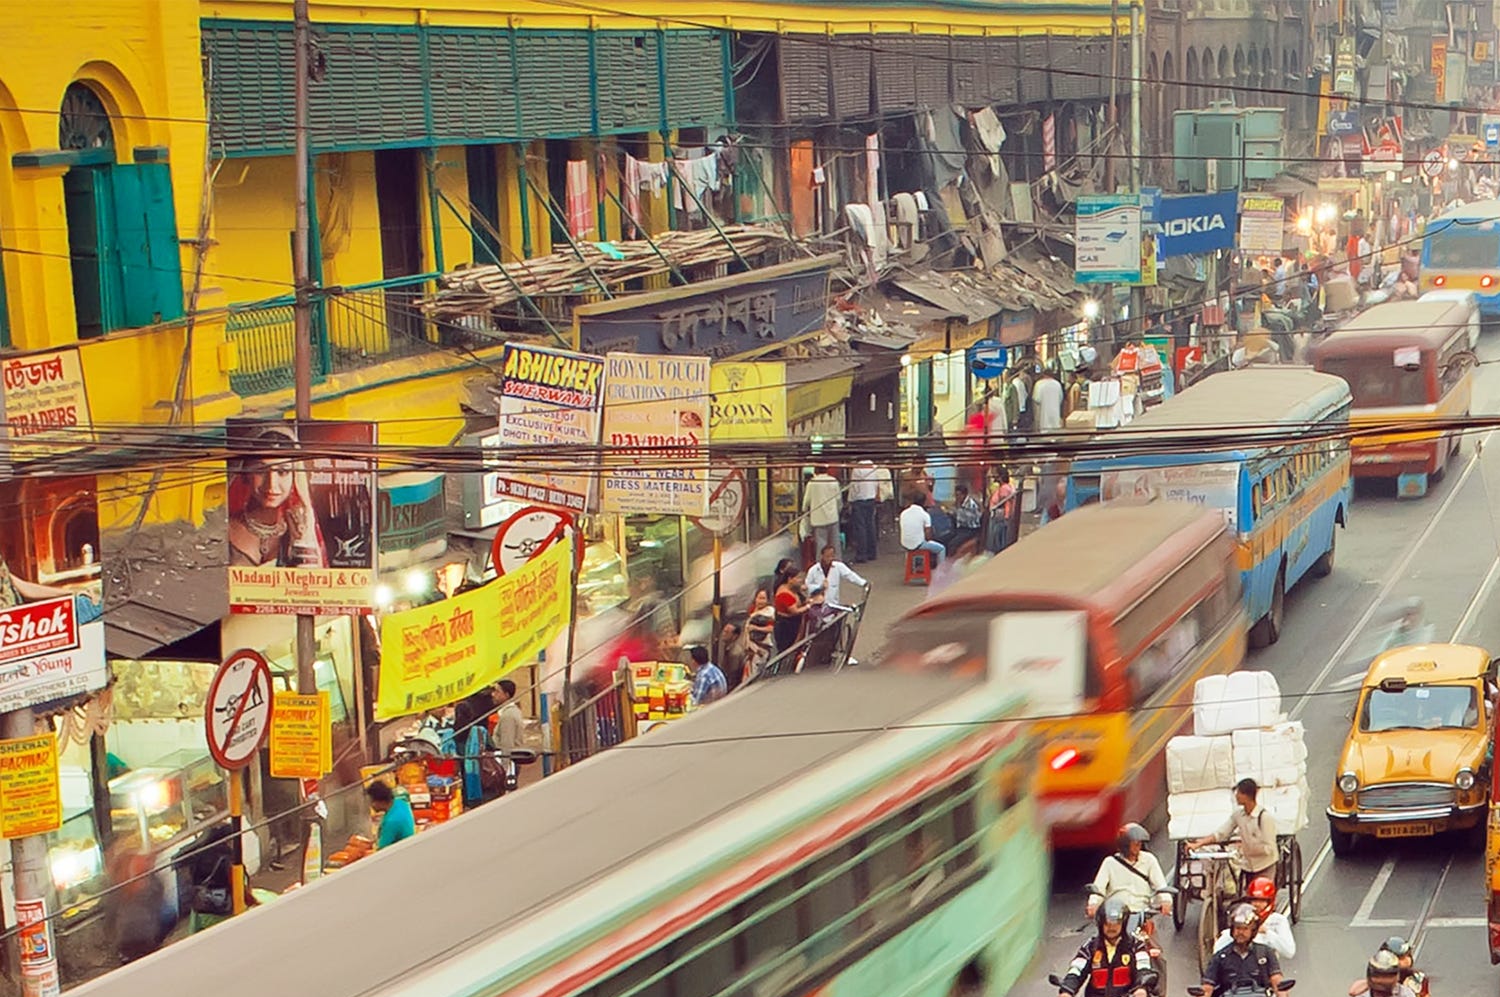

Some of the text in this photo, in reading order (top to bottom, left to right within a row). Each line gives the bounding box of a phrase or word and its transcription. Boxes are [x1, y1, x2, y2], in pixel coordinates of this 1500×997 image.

[1158, 214, 1226, 238] NOKIA
[504, 348, 602, 395] ABHISHEK
[609, 359, 705, 381] ROYAL TOUCH
[503, 381, 594, 408] SHERWANI
[608, 383, 667, 400] CREATIONS
[8, 405, 78, 438] TRADERS
[710, 402, 773, 423] ROWN
[503, 428, 549, 444] DHOTI SET
[506, 414, 588, 439] EXCLUSIVE KURTA
[606, 479, 703, 494] DRESS MATERIALS
[232, 570, 280, 588] Madanji
[284, 572, 333, 590] Meghraj
[337, 573, 347, 586] &
[32, 656, 72, 674] Young
